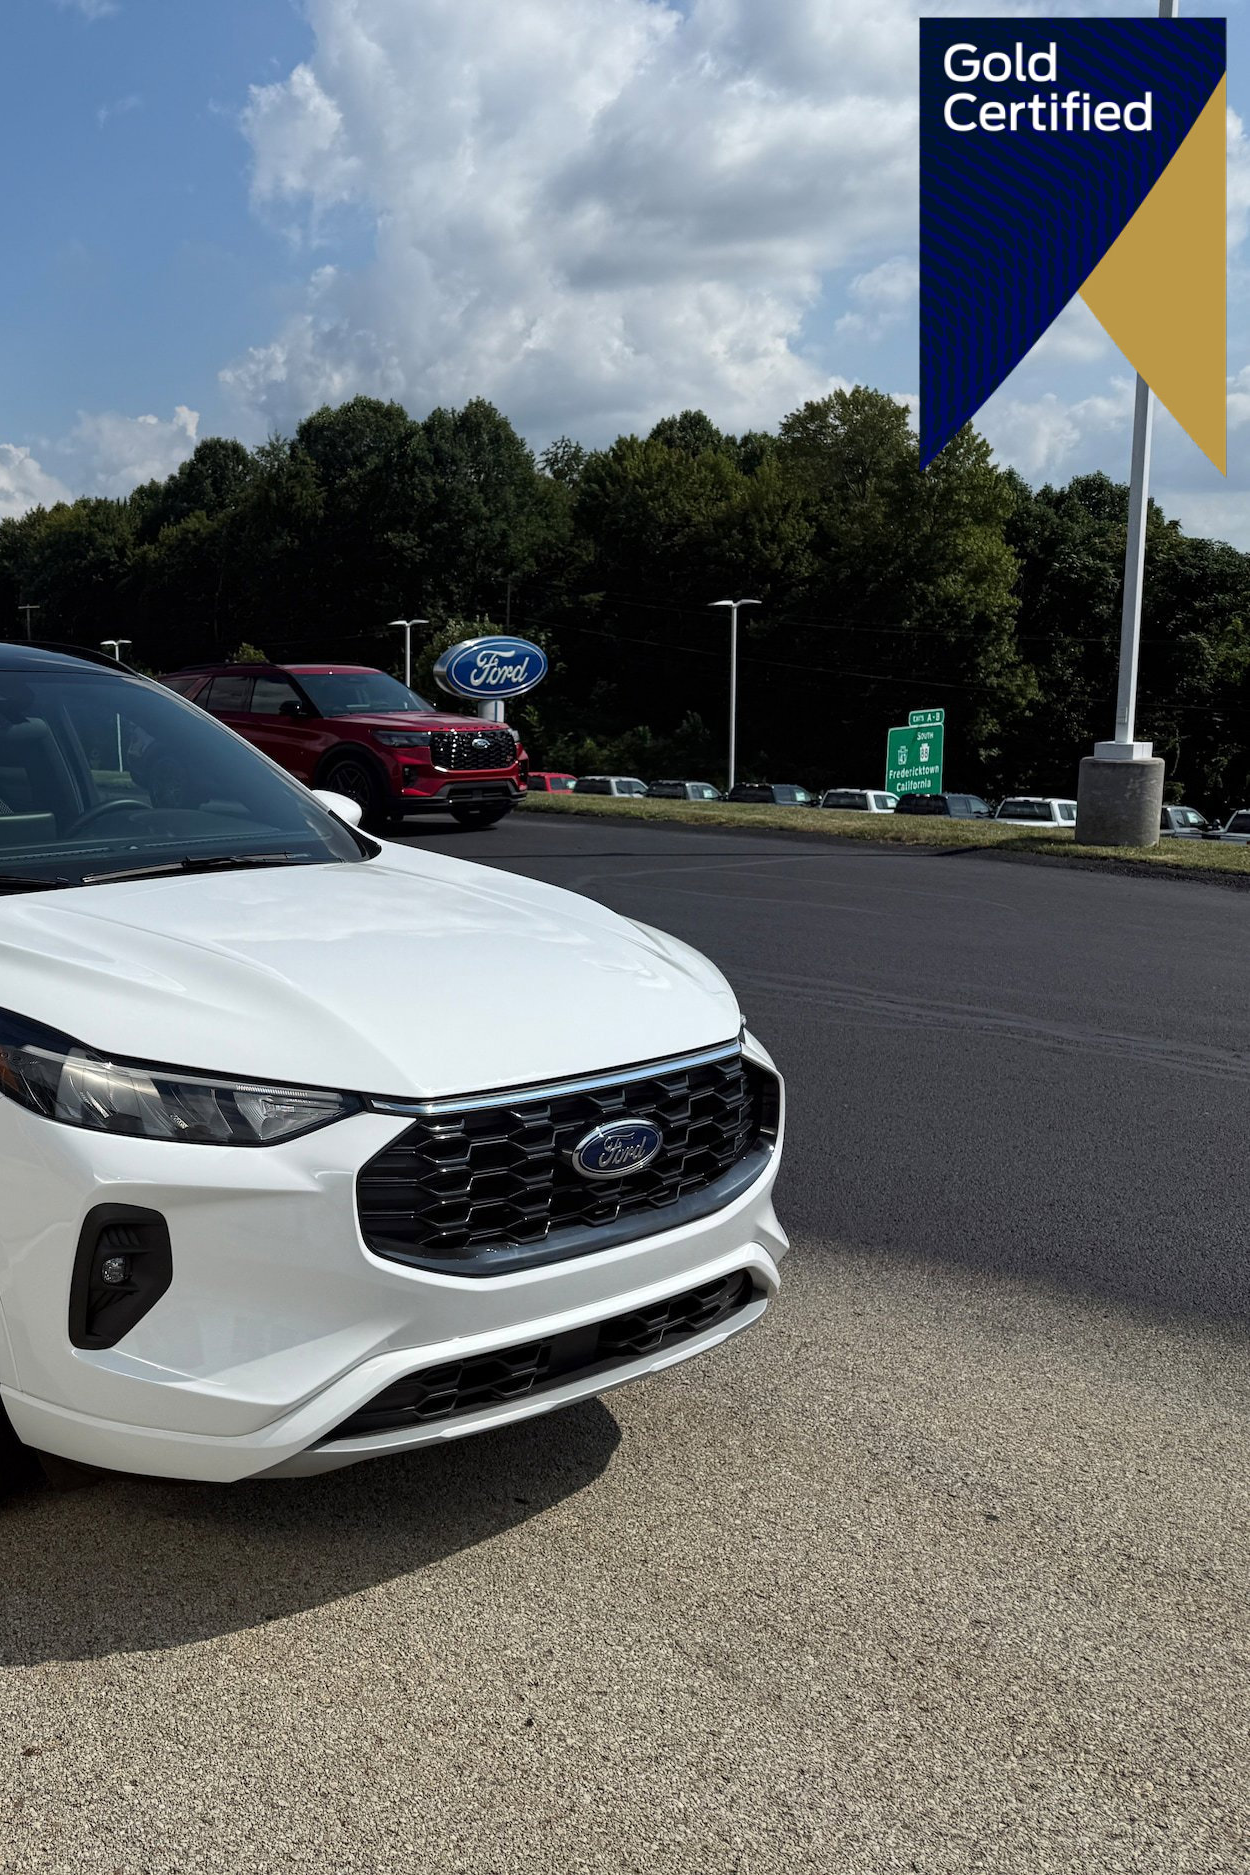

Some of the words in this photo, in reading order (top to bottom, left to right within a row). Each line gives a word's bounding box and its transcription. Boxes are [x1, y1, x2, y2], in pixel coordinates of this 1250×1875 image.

[470, 650, 530, 686] Ford
[917, 732, 934, 741] SOUTH
[889, 765, 940, 780] Fredericktown
[896, 779, 932, 792] California
[598, 1131, 648, 1168] Ford
